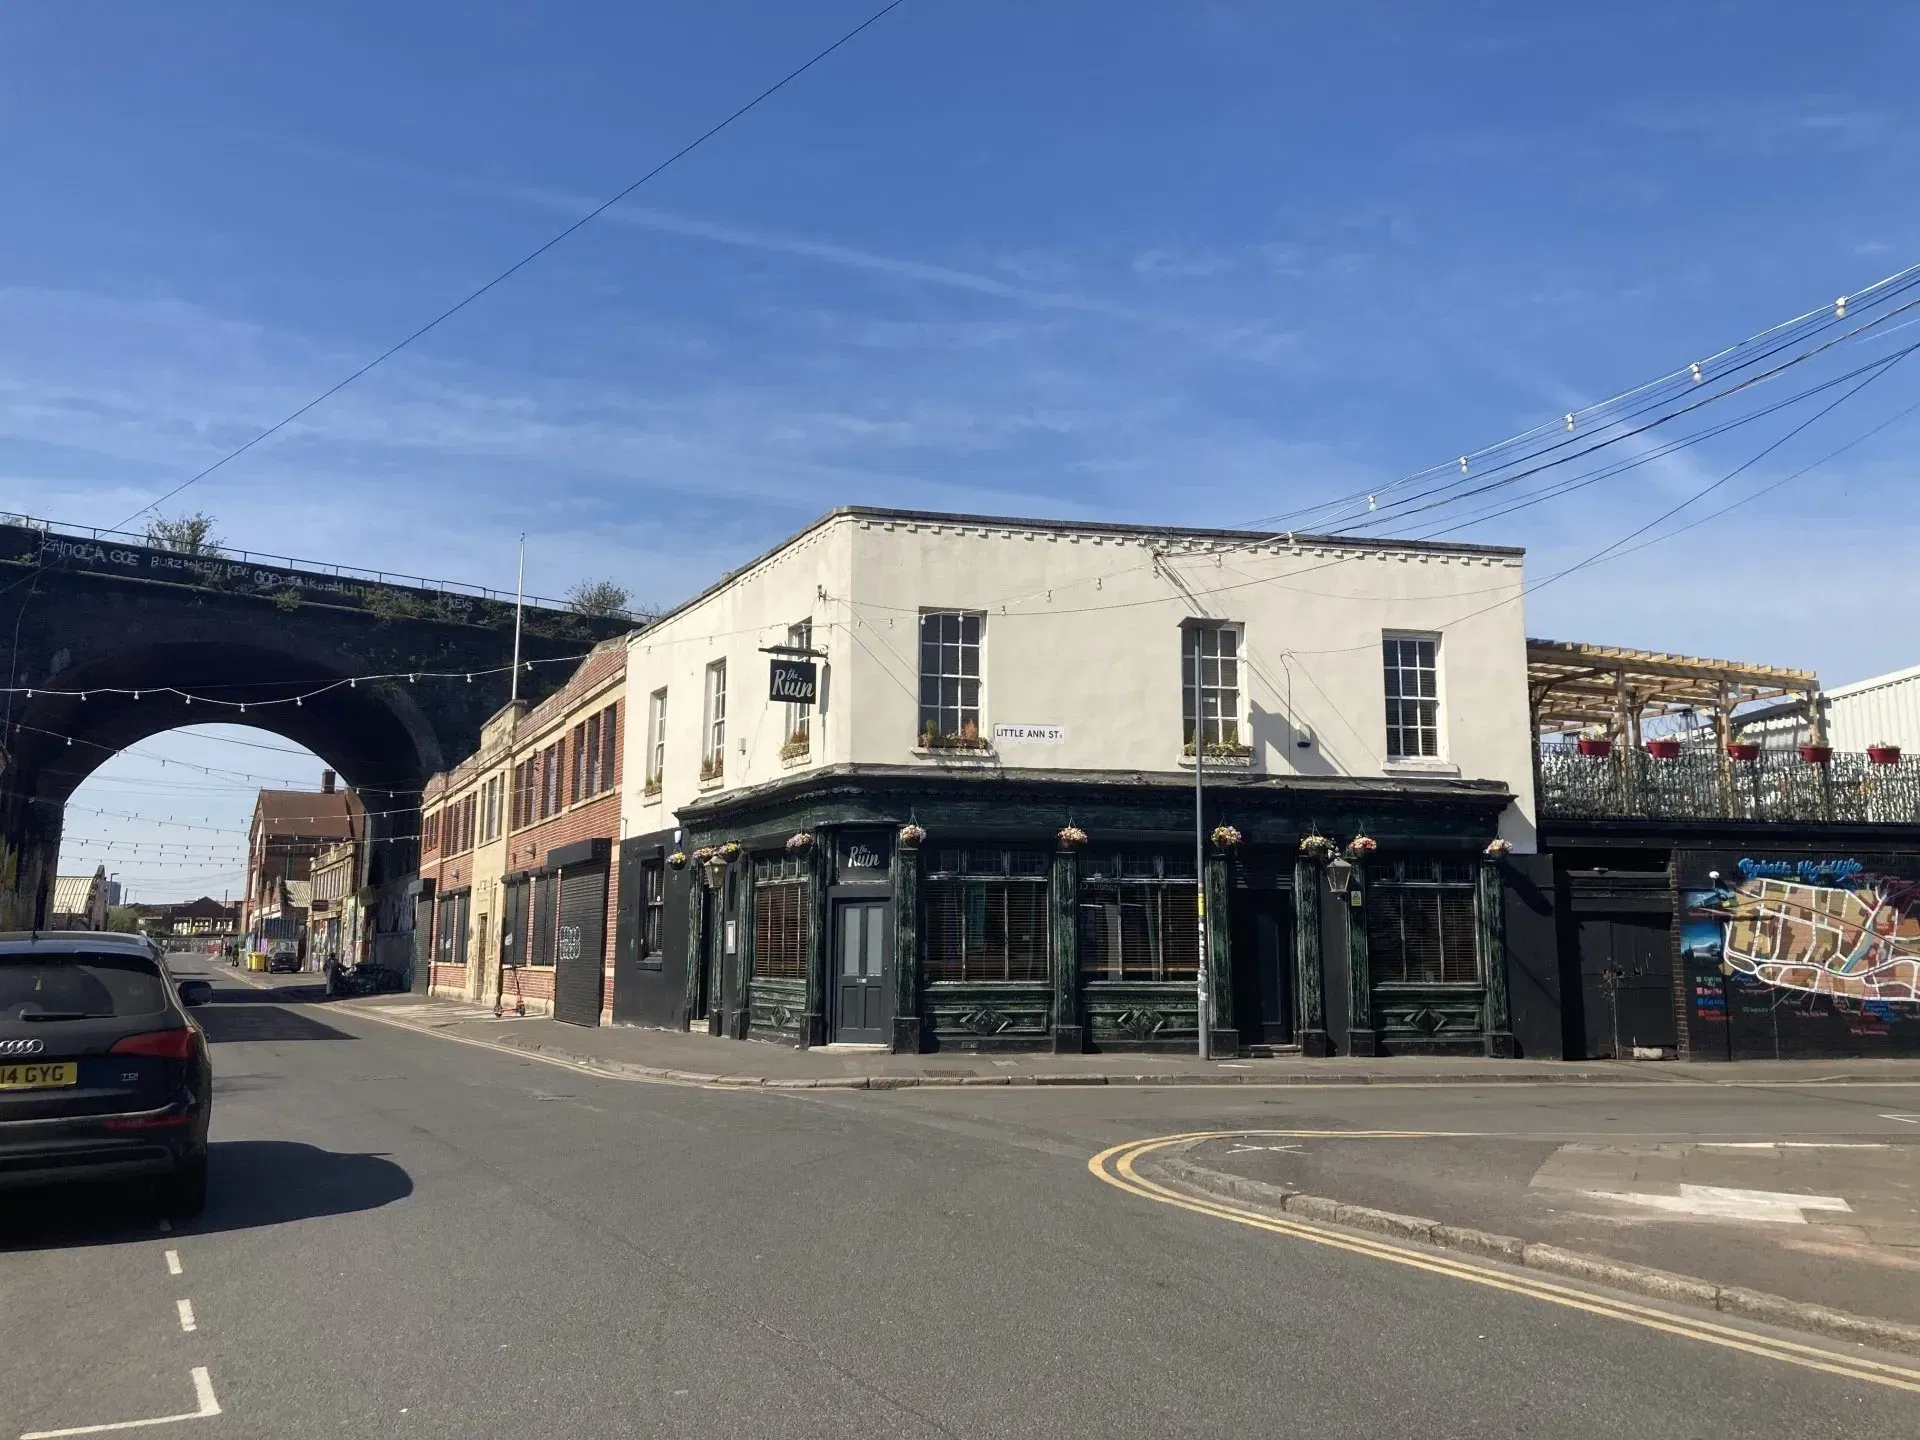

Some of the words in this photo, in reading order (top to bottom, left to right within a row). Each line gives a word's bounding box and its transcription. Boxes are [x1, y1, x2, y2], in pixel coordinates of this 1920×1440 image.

[787, 667, 799, 681] the
[772, 669, 815, 698] Ruin
[996, 728, 1024, 738] LITTLE
[1027, 729, 1046, 739] ANN
[1048, 730, 1059, 739] ST
[848, 846, 880, 868] Ruin
[25, 1065, 64, 1083] GYG
